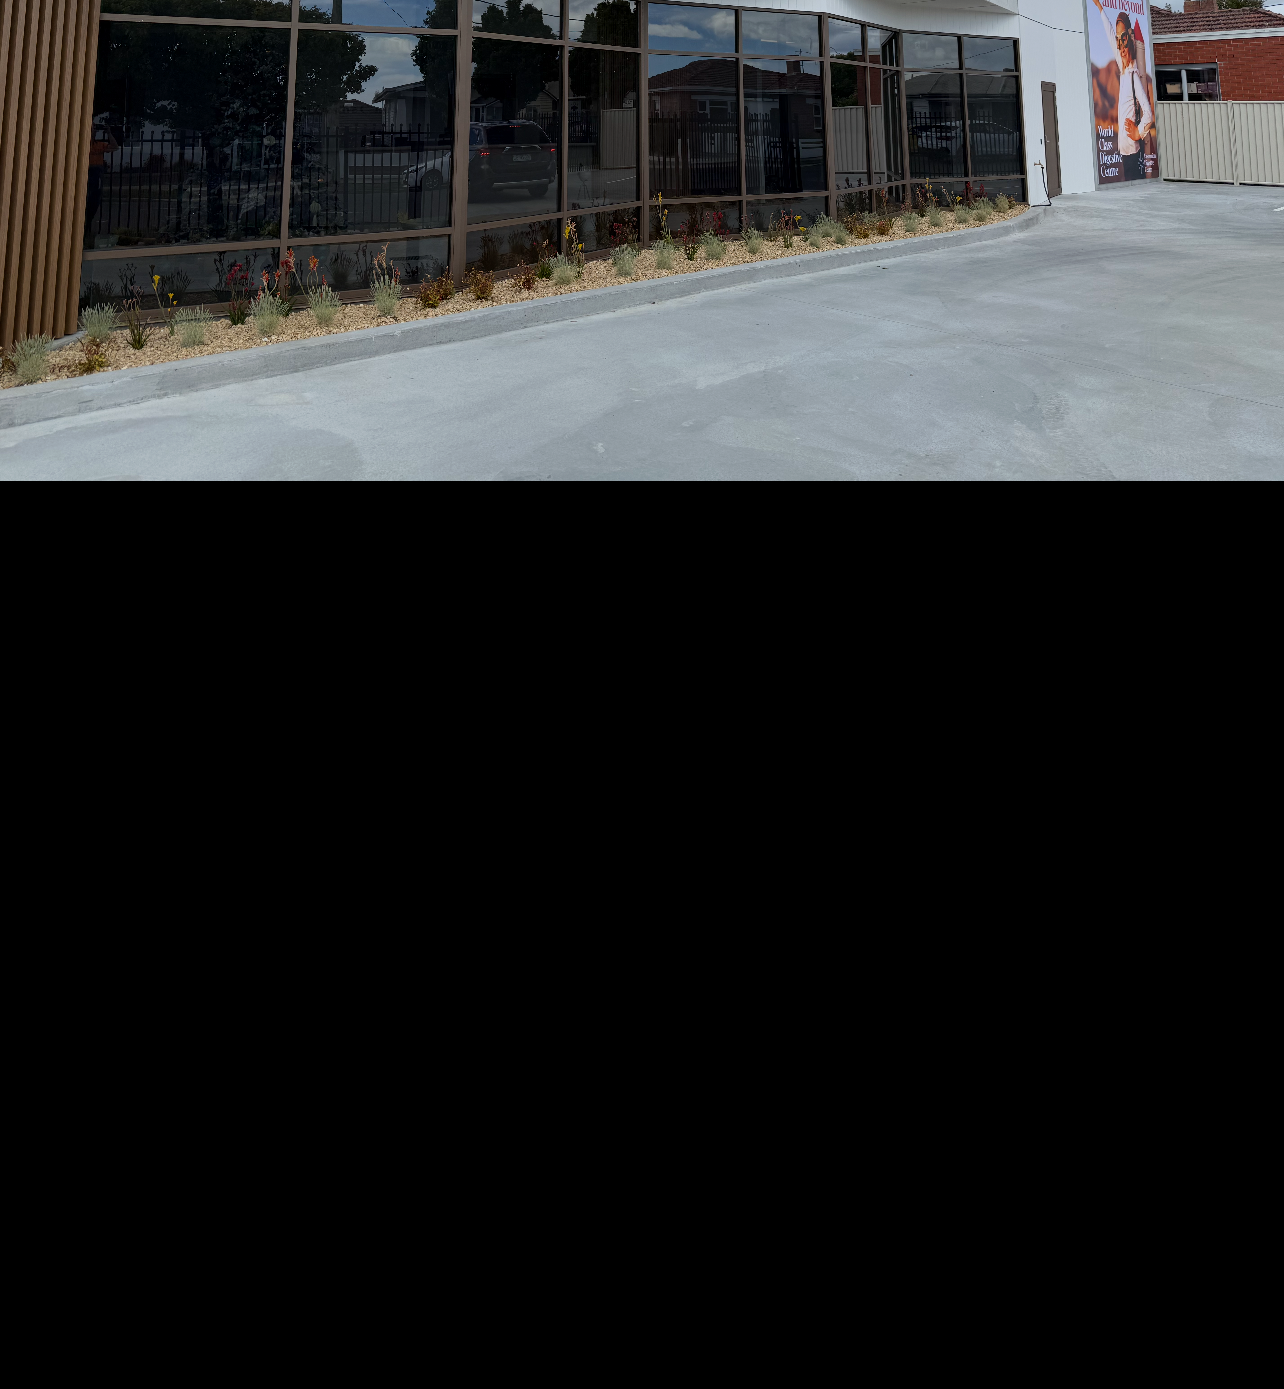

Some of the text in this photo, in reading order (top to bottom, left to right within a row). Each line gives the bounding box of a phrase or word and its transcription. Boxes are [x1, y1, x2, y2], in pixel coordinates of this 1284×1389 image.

[1098, 125, 1114, 137] World
[1098, 138, 1113, 151] Class
[1099, 151, 1123, 167] Digestive
